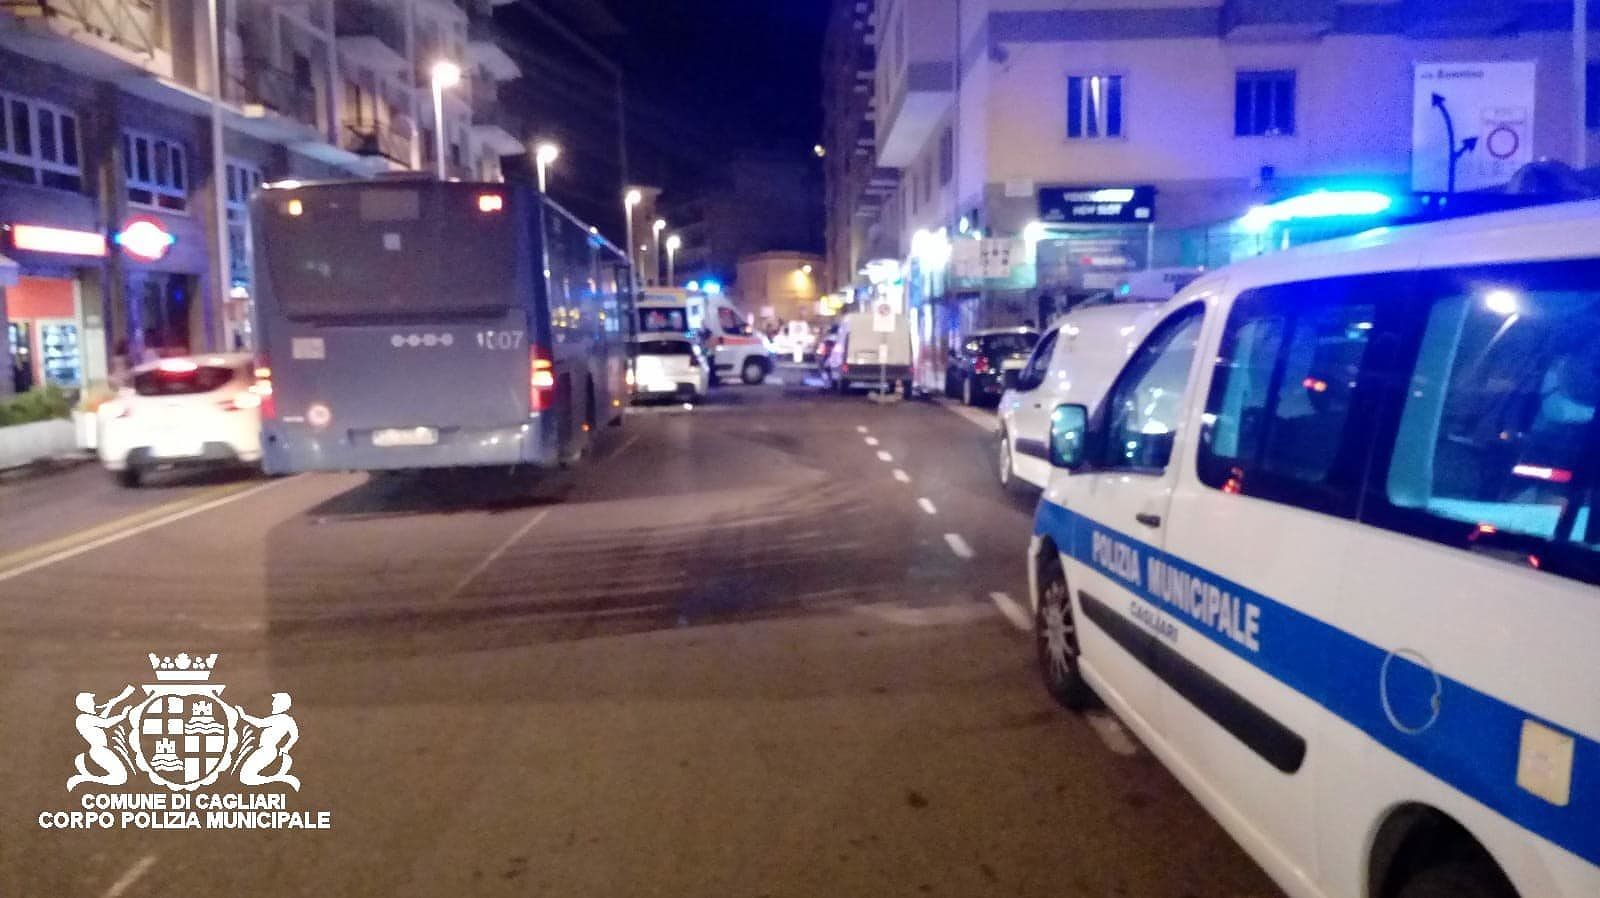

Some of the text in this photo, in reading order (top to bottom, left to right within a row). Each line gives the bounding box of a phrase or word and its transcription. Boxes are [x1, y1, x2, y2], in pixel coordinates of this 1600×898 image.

[1092, 530, 1261, 652] POLIZIA MUNICIPALE
[1130, 601, 1179, 643] CAGLIARI
